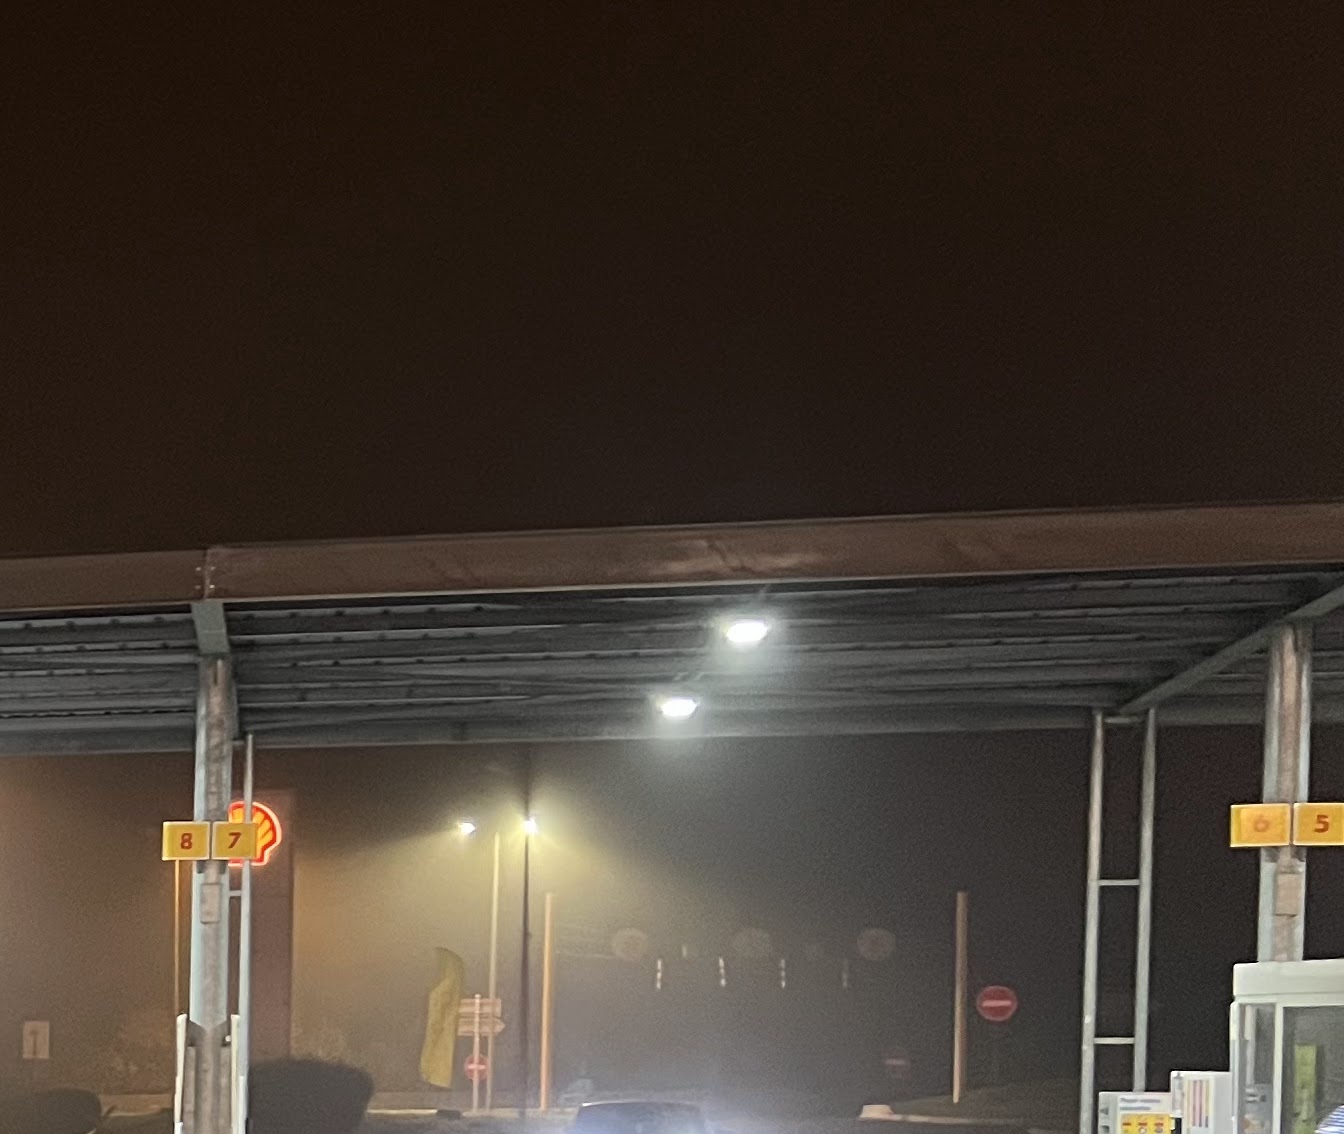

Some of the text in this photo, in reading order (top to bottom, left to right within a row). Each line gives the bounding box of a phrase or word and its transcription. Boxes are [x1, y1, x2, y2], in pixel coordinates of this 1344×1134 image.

[1255, 814, 1270, 833] 6
[1314, 814, 1330, 834] 5
[180, 833, 193, 850] 8
[228, 832, 242, 849] 7
